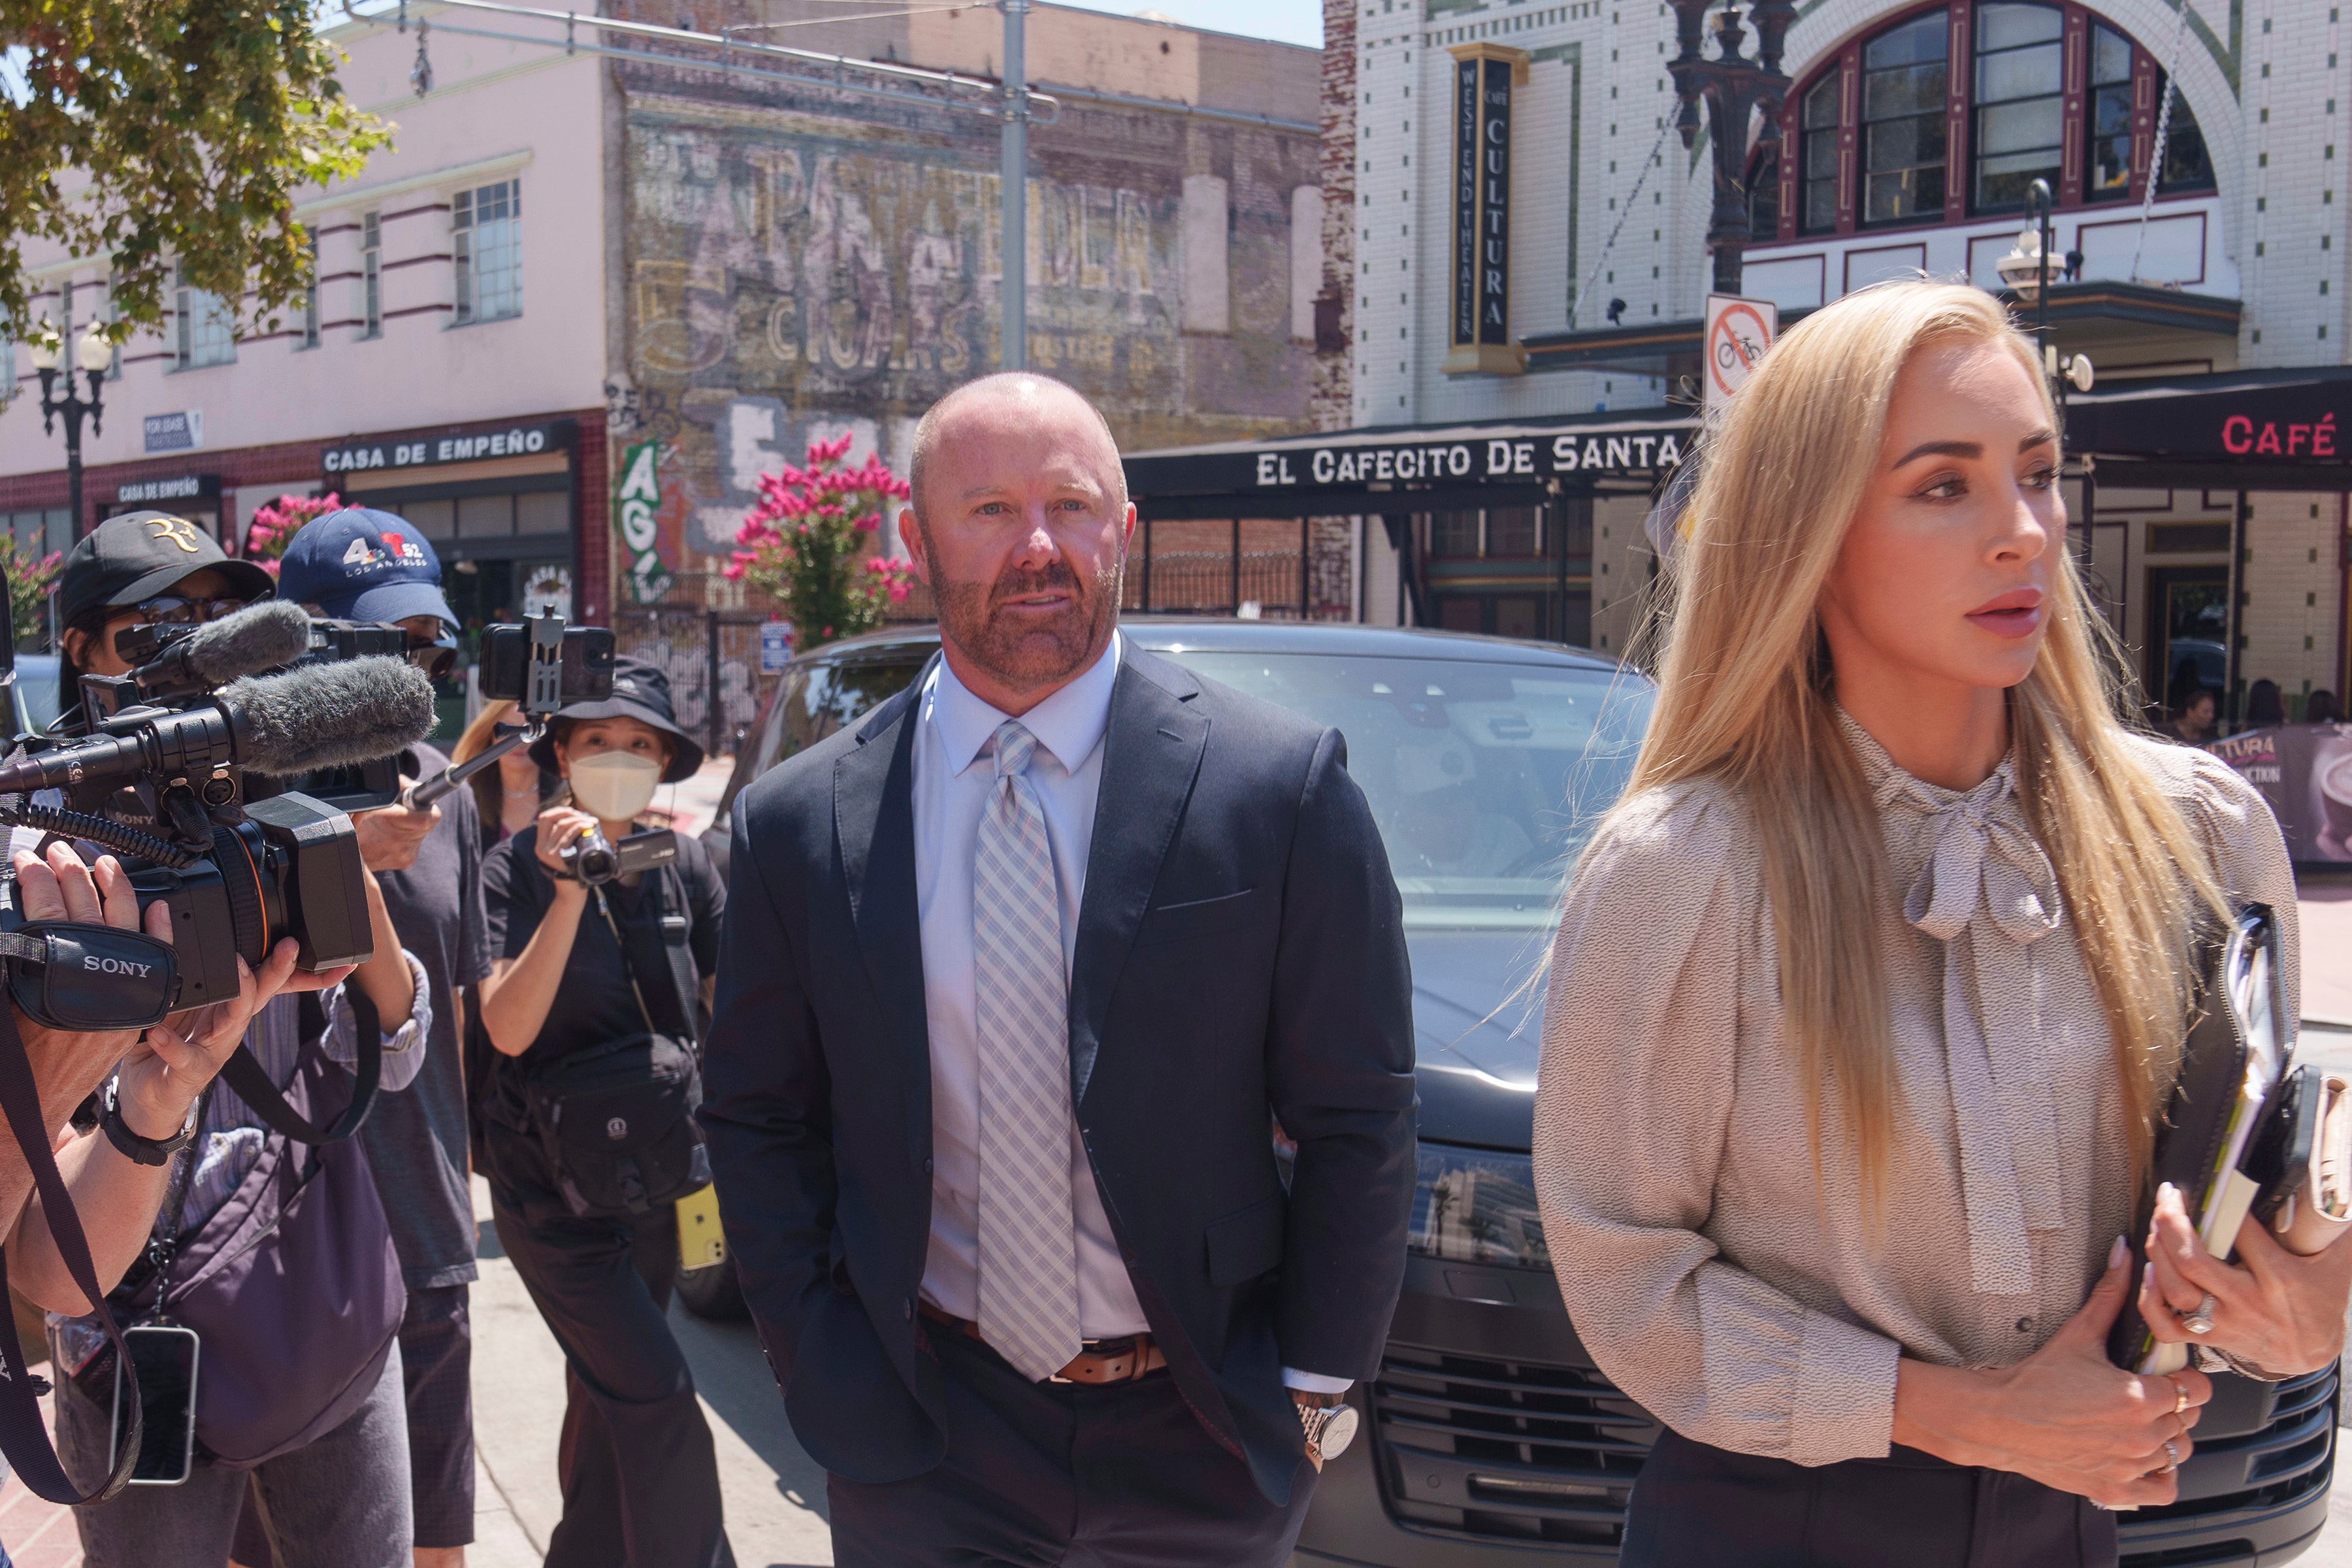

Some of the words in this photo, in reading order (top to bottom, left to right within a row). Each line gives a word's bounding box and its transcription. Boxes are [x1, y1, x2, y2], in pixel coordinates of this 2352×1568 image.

[1462, 69, 1475, 142] WEST
[1461, 148, 1473, 203] END
[1484, 118, 1506, 325] CULTURA
[1461, 209, 1473, 335] THEATER
[323, 448, 385, 472] CASA
[394, 443, 427, 465] DE
[438, 428, 545, 461] EMPEÑO
[2222, 412, 2336, 456] CAFÉ
[1256, 453, 1296, 486] EL
[1312, 445, 1471, 484] CAFECITO
[1486, 439, 1535, 475] DE
[1552, 434, 1681, 471] SANTA
[118, 485, 144, 502] CASA
[144, 482, 158, 500] DE
[159, 475, 199, 498] EMPEÑO
[345, 566, 372, 578] LOS
[376, 558, 428, 570] ANGELES
[115, 811, 154, 826] SONY
[84, 955, 152, 978] SONY
